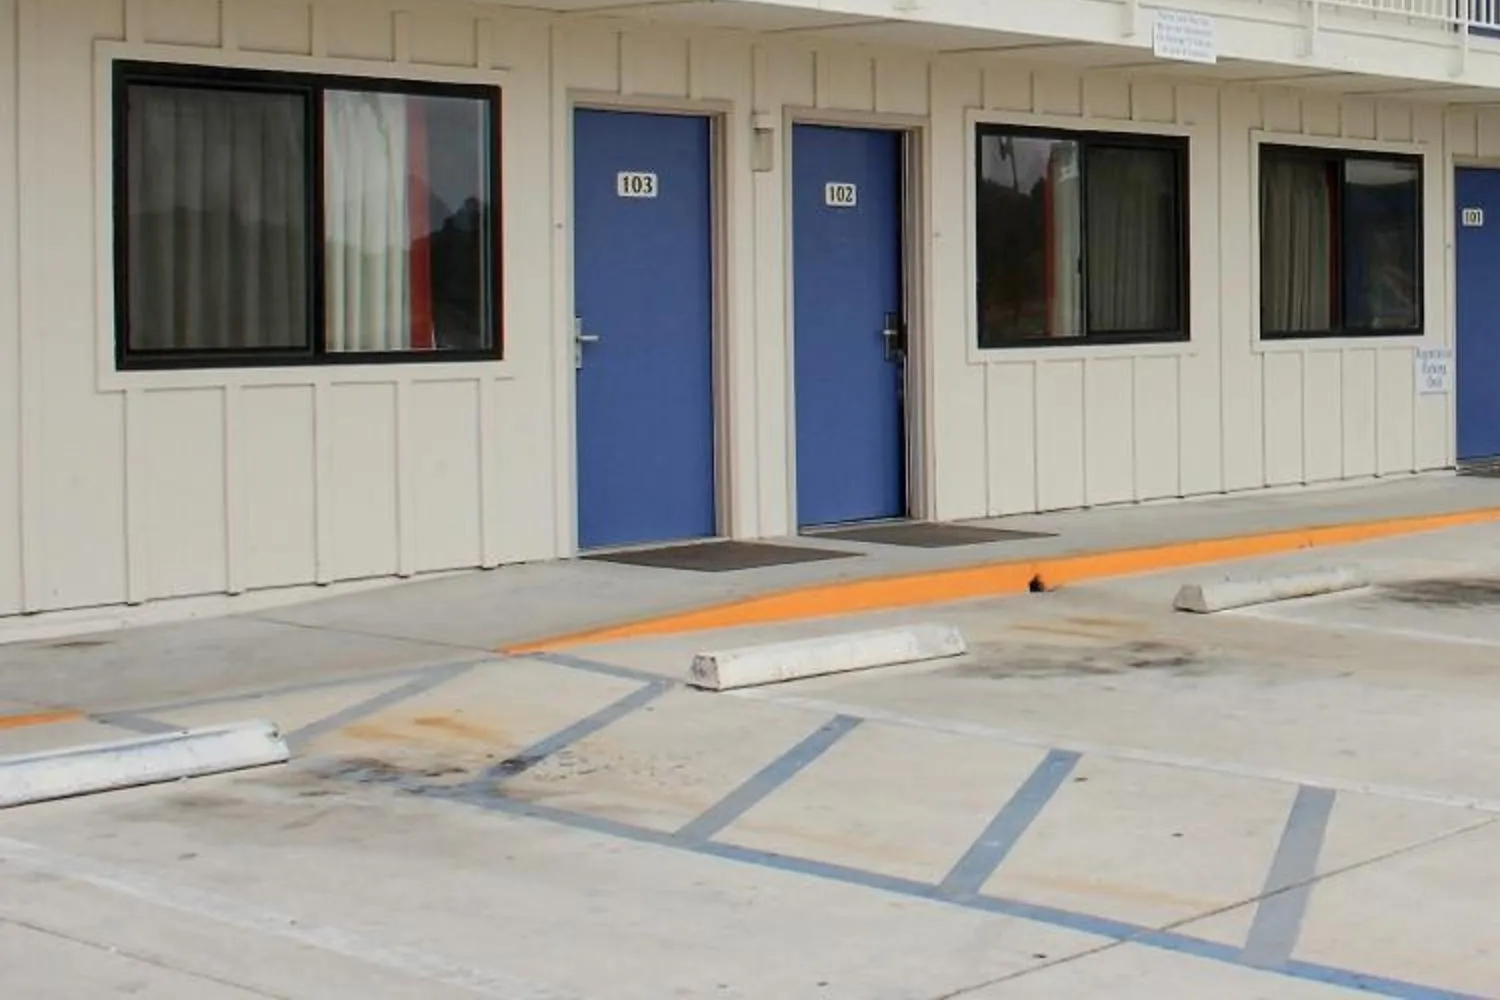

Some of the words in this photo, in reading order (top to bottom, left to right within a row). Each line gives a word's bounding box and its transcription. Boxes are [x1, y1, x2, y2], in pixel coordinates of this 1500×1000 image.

[623, 175, 653, 193] 103
[830, 185, 853, 203] 102
[1465, 210, 1481, 224] 101
